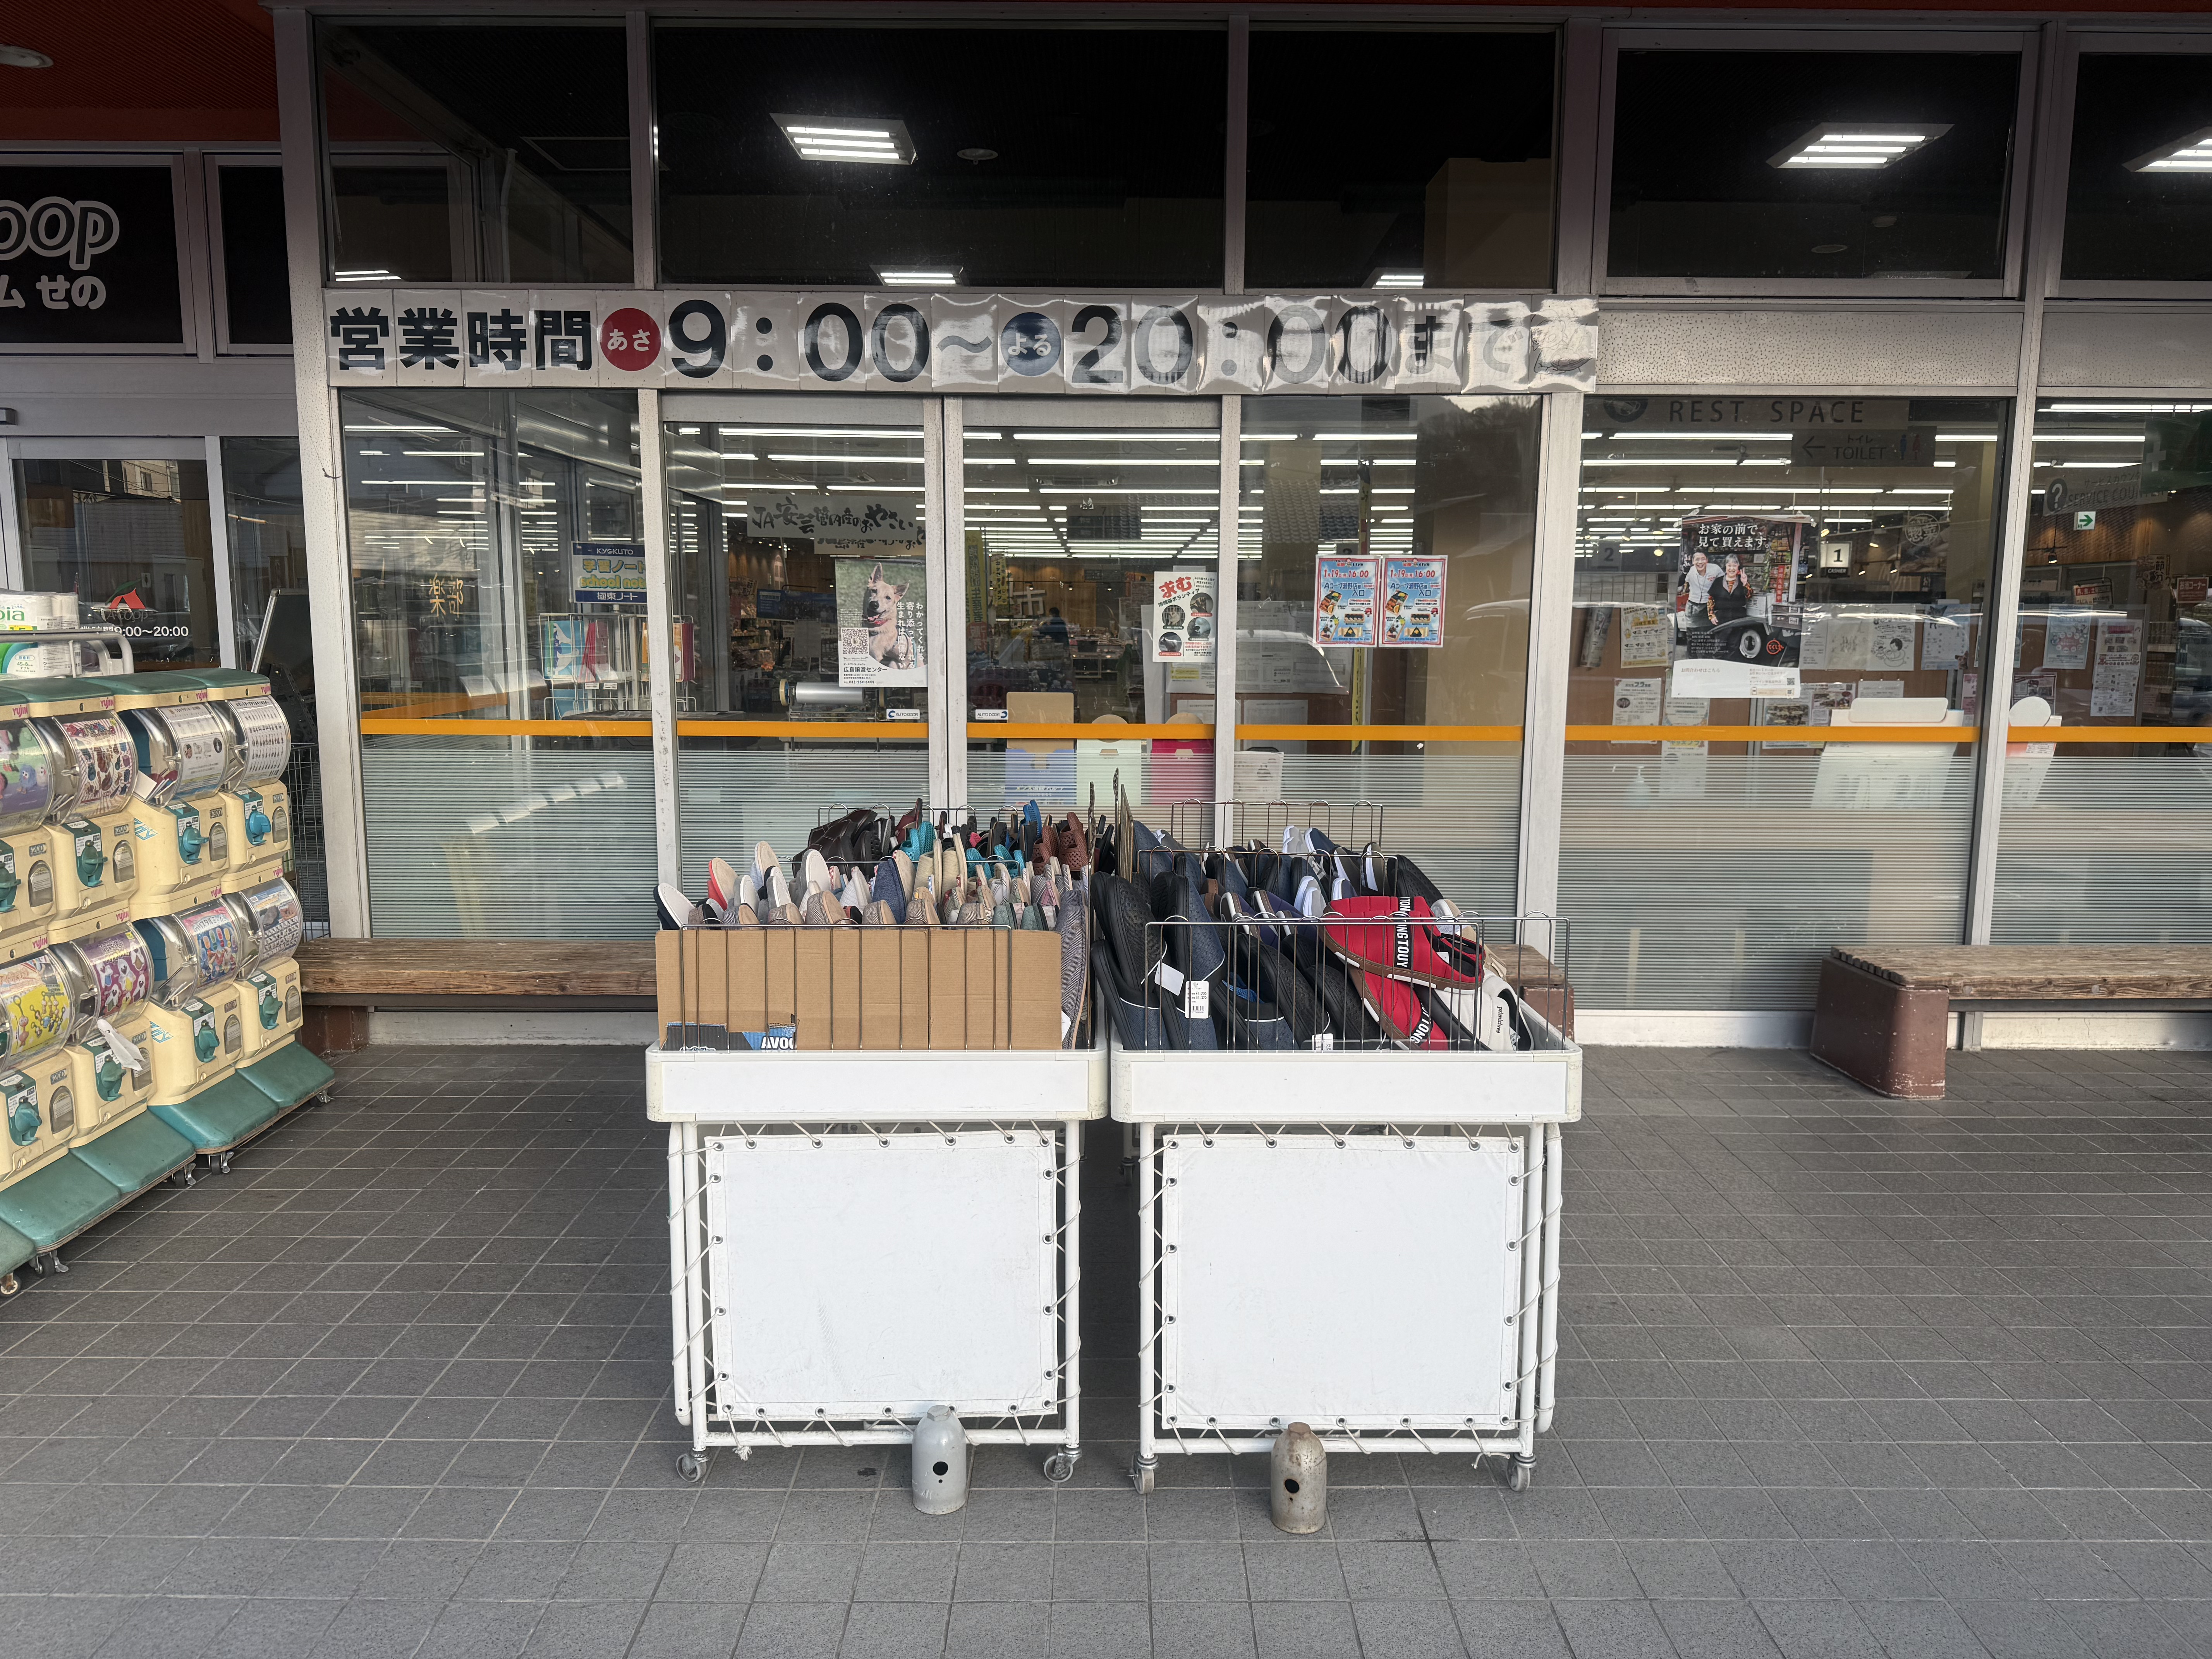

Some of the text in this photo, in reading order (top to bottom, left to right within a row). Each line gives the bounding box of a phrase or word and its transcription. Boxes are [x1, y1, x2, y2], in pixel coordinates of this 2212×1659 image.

[36, 275, 106, 309] せの
[330, 306, 592, 371] 営業時間
[606, 329, 651, 353] あさ
[1007, 333, 1051, 356] よる
[1669, 400, 1863, 423] REST SPACE
[1833, 447, 1886, 460] TOILET
[2069, 488, 2108, 505] SERVICE
[1698, 524, 1763, 535] お家の前で、
[1697, 536, 1769, 548] 見て買えます。
[1604, 547, 1613, 561] 2
[1834, 549, 1843, 562] 1
[580, 575, 621, 588] school
[1159, 577, 1192, 598] 求む
[598, 592, 637, 600] 極東ノート
[916, 603, 925, 661] わかってくれる
